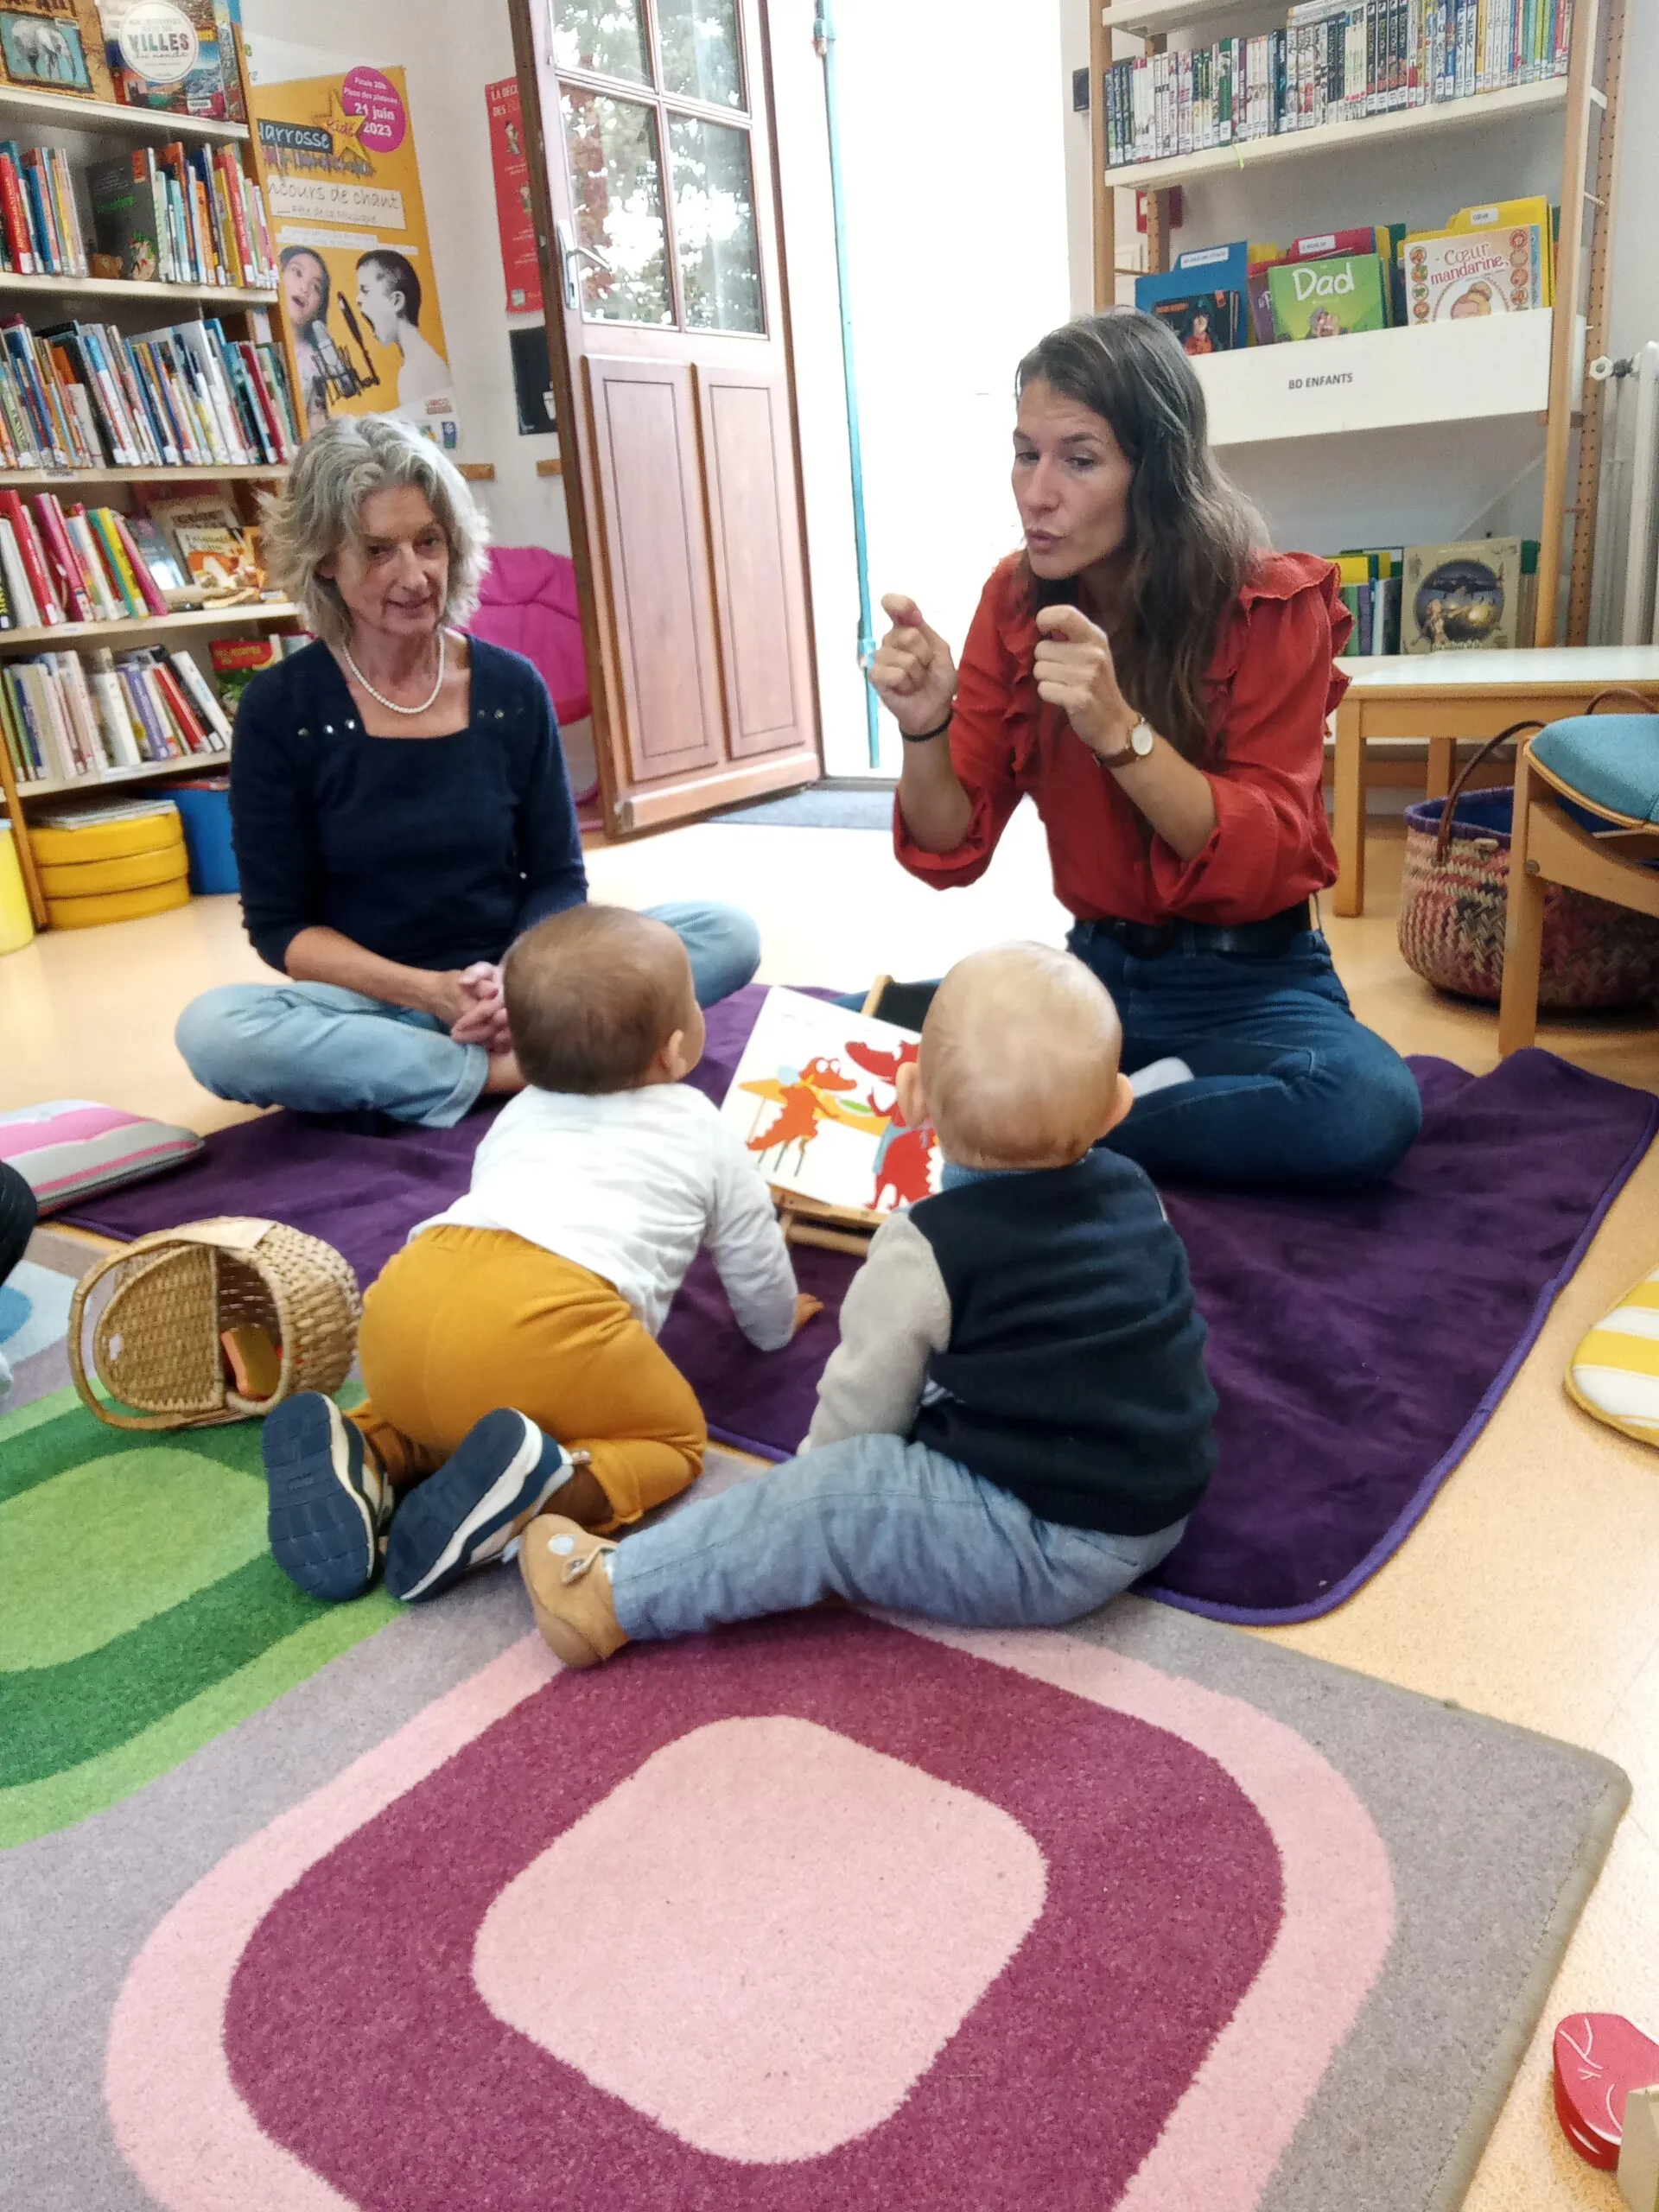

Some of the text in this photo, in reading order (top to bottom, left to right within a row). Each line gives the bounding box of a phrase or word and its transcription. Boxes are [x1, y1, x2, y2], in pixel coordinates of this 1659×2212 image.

[127, 33, 189, 53] VILLES
[354, 102, 396, 120] 21 juin
[363, 123, 393, 137] 2023
[331, 186, 349, 205] de
[353, 188, 400, 210] chant
[1292, 262, 1355, 302] Dad
[1288, 372, 1353, 390] BD ENFANTS
